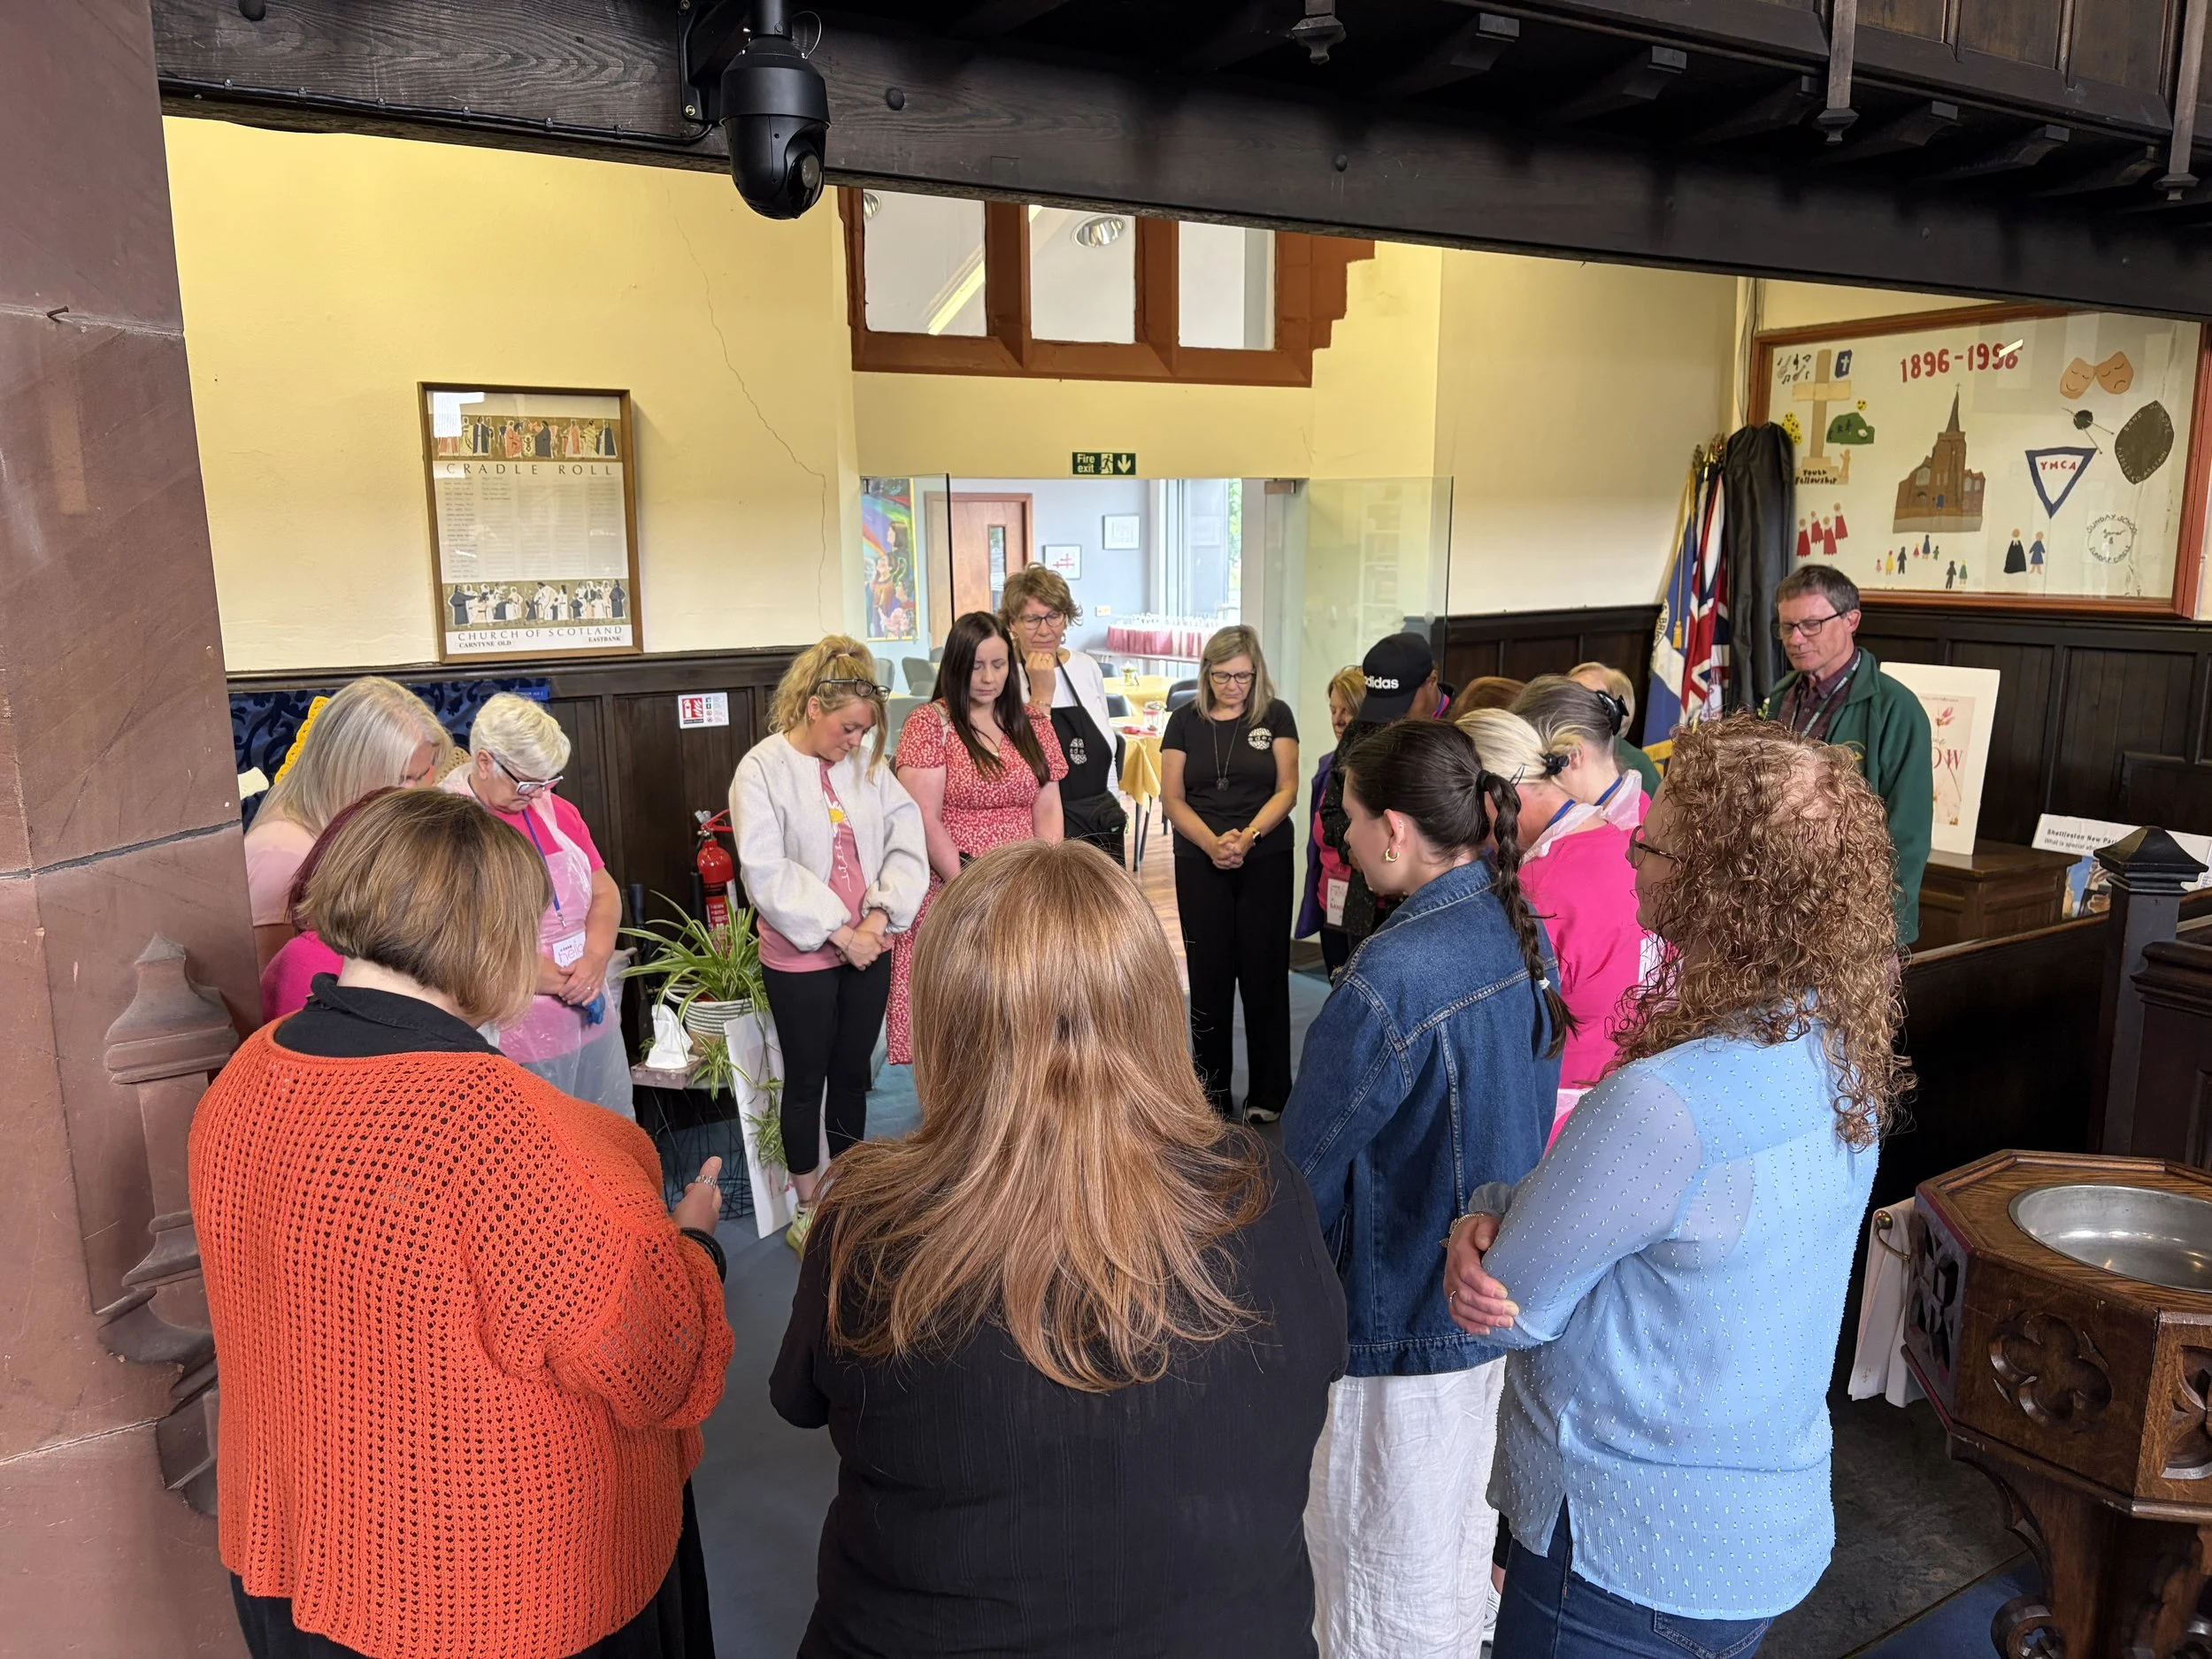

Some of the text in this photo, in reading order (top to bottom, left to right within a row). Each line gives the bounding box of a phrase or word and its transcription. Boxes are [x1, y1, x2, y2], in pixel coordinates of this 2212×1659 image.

[1077, 453, 1095, 464] Fire
[446, 463, 612, 476] CRADLE ROLL
[1077, 464, 1095, 473] exit
[2039, 460, 2077, 471] YMCA
[2086, 513, 2116, 534] SUNDAY
[457, 630, 518, 641] CHURCH
[549, 626, 622, 637] SCOTLAND
[1364, 675, 1400, 689] didas
[2047, 828, 2085, 840] Shettleston
